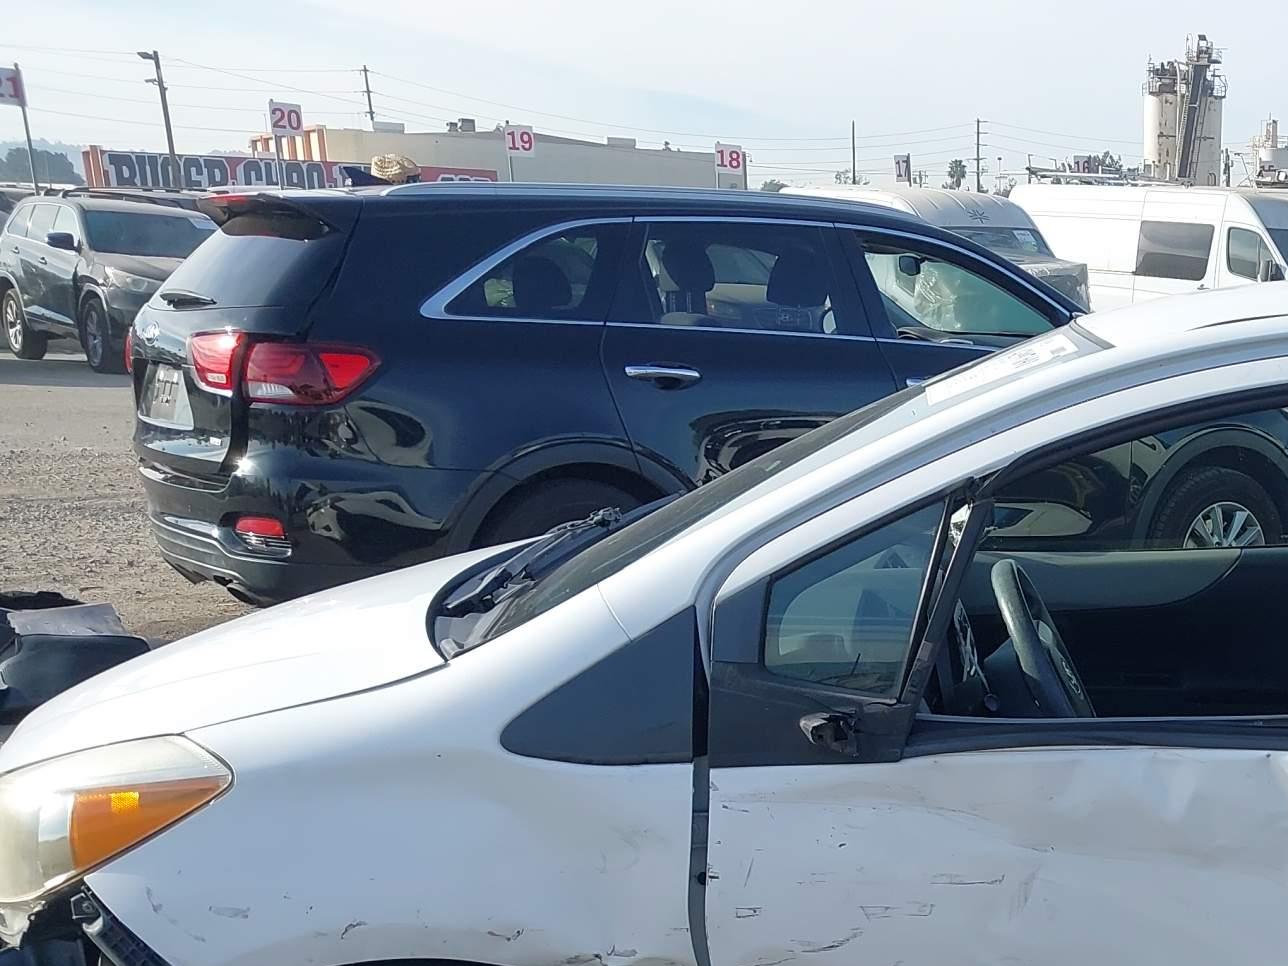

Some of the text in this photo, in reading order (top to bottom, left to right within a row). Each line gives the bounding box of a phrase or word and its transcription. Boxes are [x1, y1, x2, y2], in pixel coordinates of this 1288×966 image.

[0, 77, 20, 97] 1
[271, 107, 301, 131] 20
[507, 130, 533, 152] 19
[716, 149, 741, 169] 18
